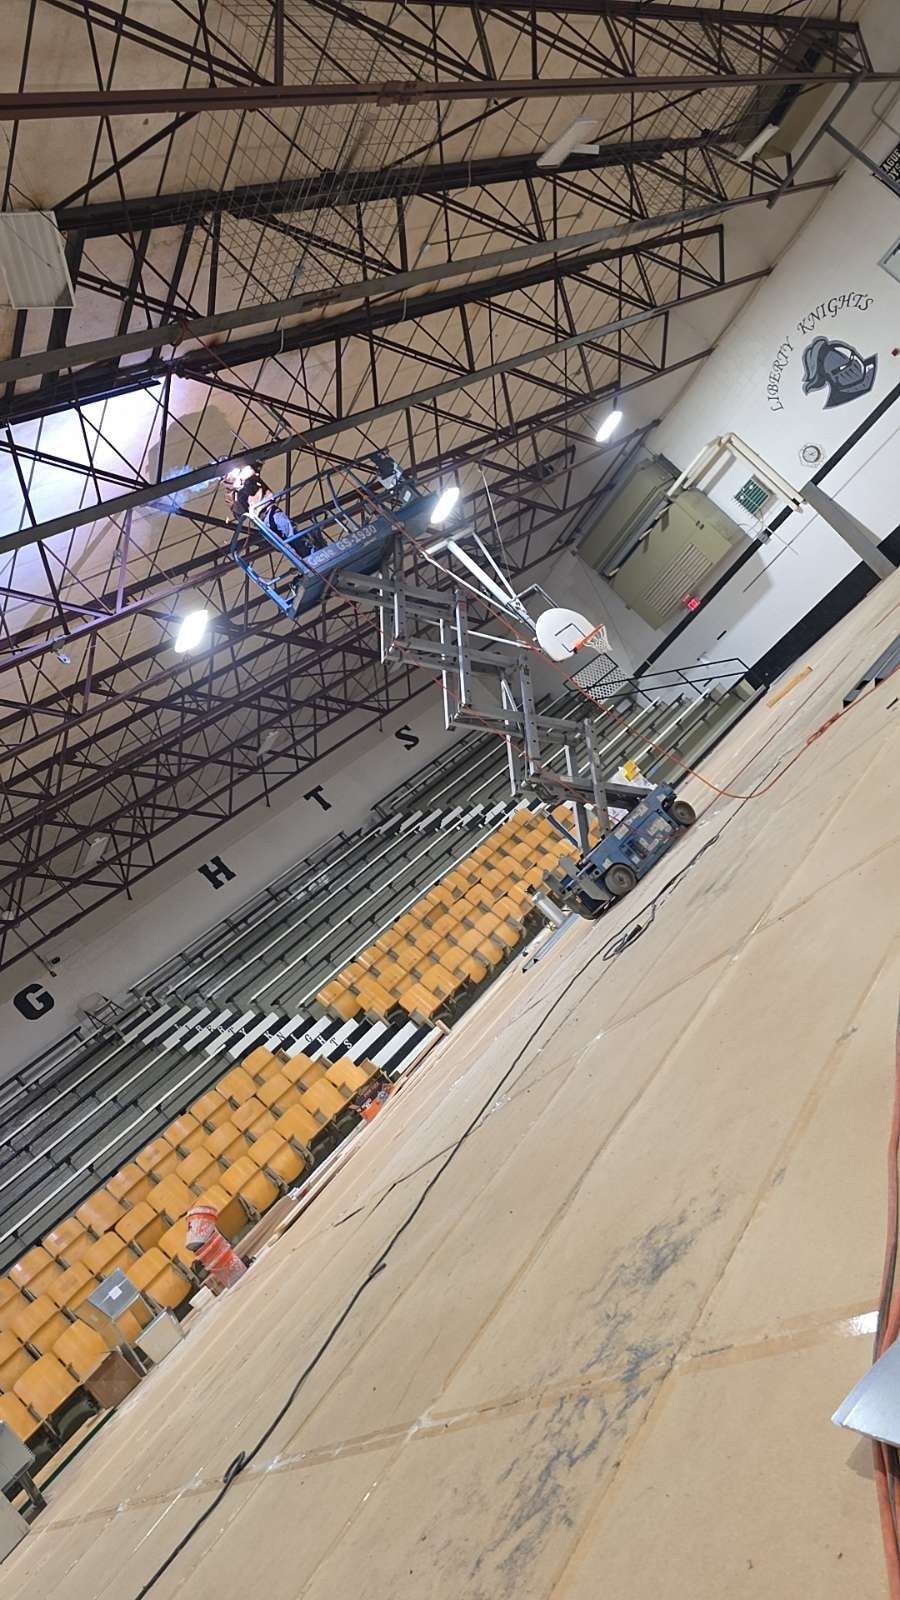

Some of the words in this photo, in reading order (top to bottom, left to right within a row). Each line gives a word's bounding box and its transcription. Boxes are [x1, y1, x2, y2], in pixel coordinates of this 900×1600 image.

[766, 336, 795, 412] LIBERTY
[797, 292, 874, 335] KNIGHTS
[264, 1030, 353, 1049] KNIGHTS
